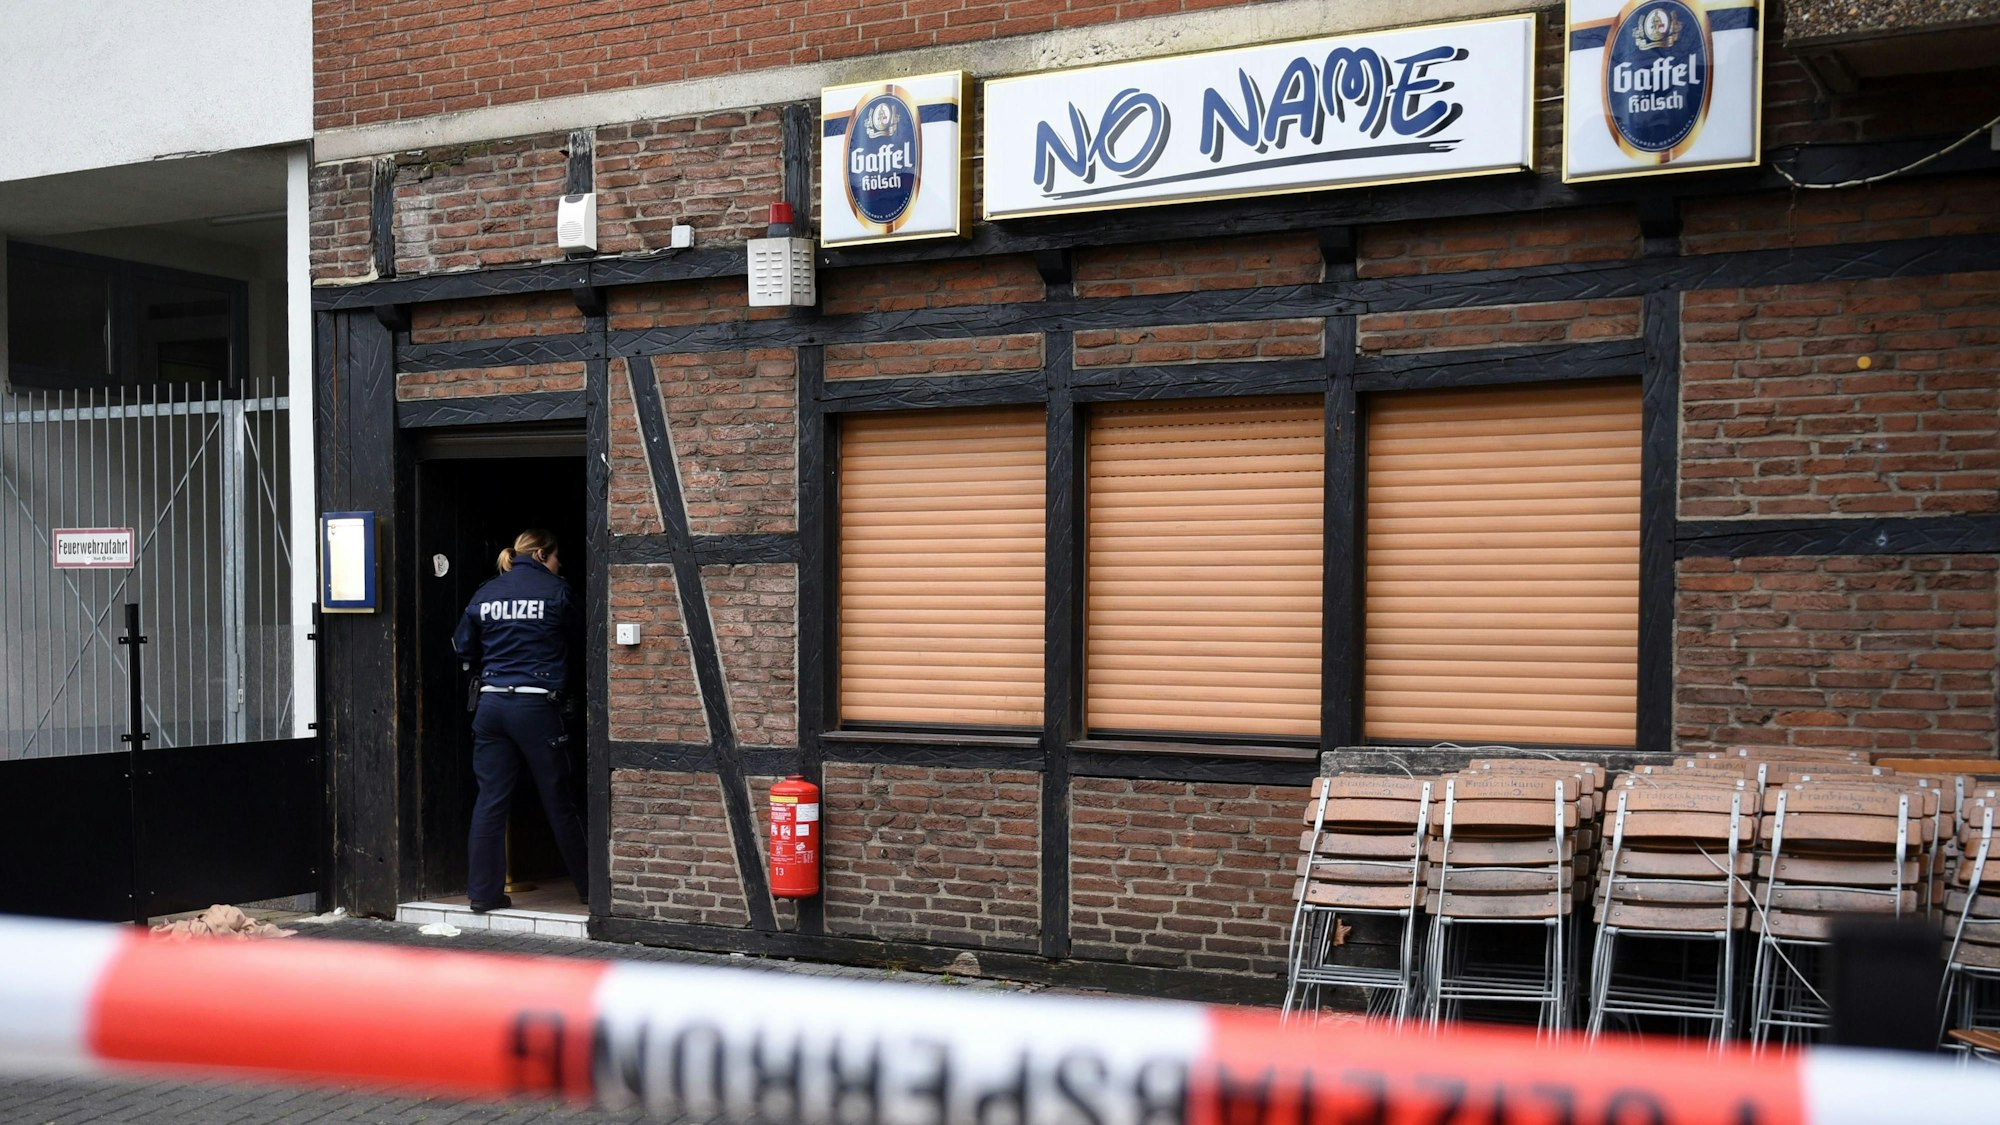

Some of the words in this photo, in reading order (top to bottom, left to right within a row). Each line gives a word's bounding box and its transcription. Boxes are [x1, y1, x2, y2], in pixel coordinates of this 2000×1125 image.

[1613, 53, 1701, 93] Gaffel
[1628, 90, 1684, 114] Kölsch
[1034, 88, 1171, 192] NO
[1199, 46, 1469, 163] NAME
[851, 141, 913, 174] Gaffel
[862, 172, 902, 191] Kölsch
[58, 539, 128, 555] Feuerwehrzufahrt
[480, 600, 545, 621] POLIZEI
